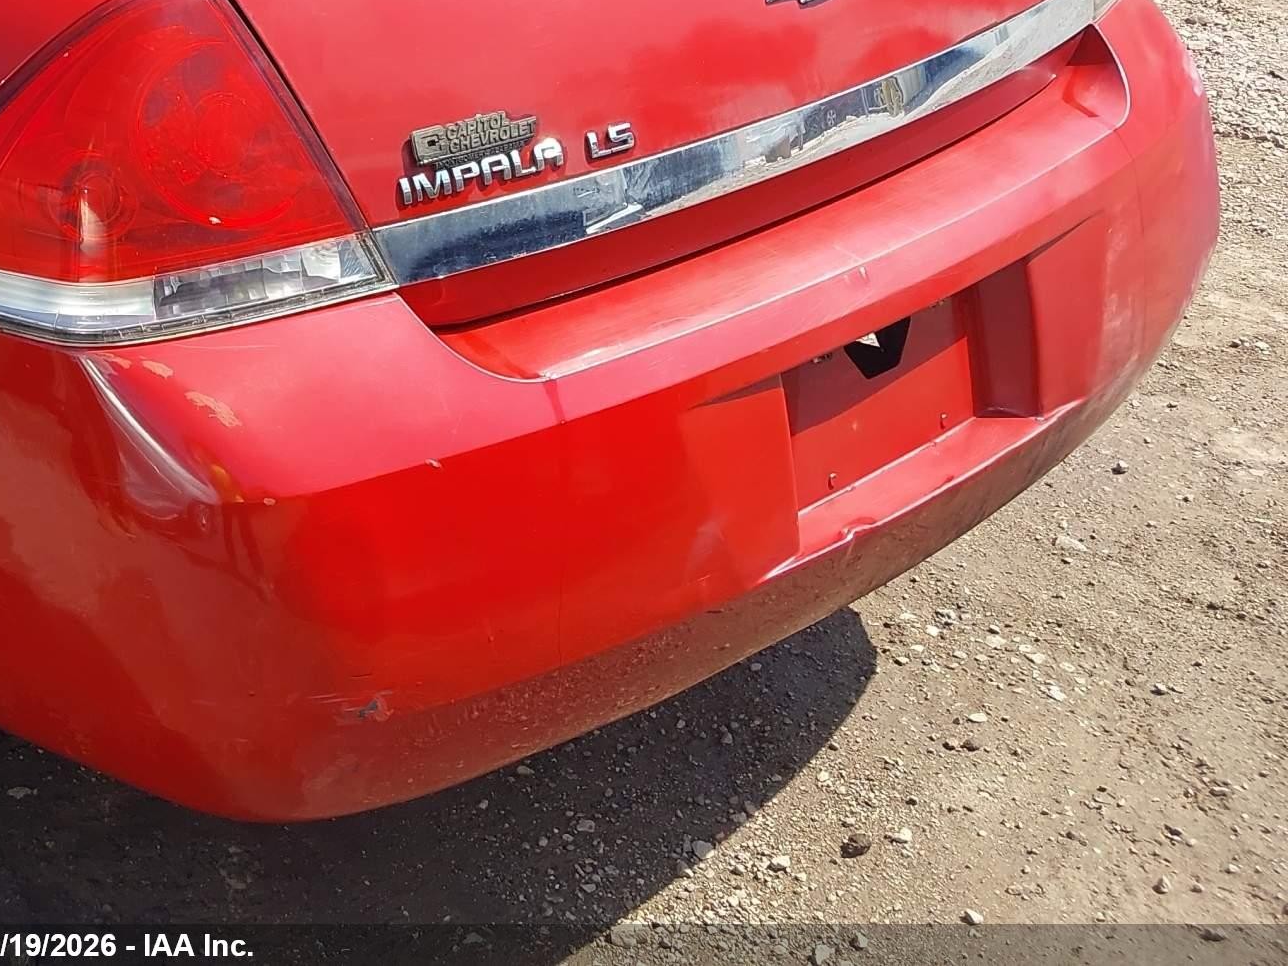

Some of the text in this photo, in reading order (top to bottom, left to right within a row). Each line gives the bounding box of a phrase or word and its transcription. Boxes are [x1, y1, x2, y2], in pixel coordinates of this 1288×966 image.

[446, 111, 510, 140] CAPITOL
[449, 119, 537, 153] CHEVROLET
[399, 137, 564, 205] IMPALA
[586, 122, 634, 158] LS
